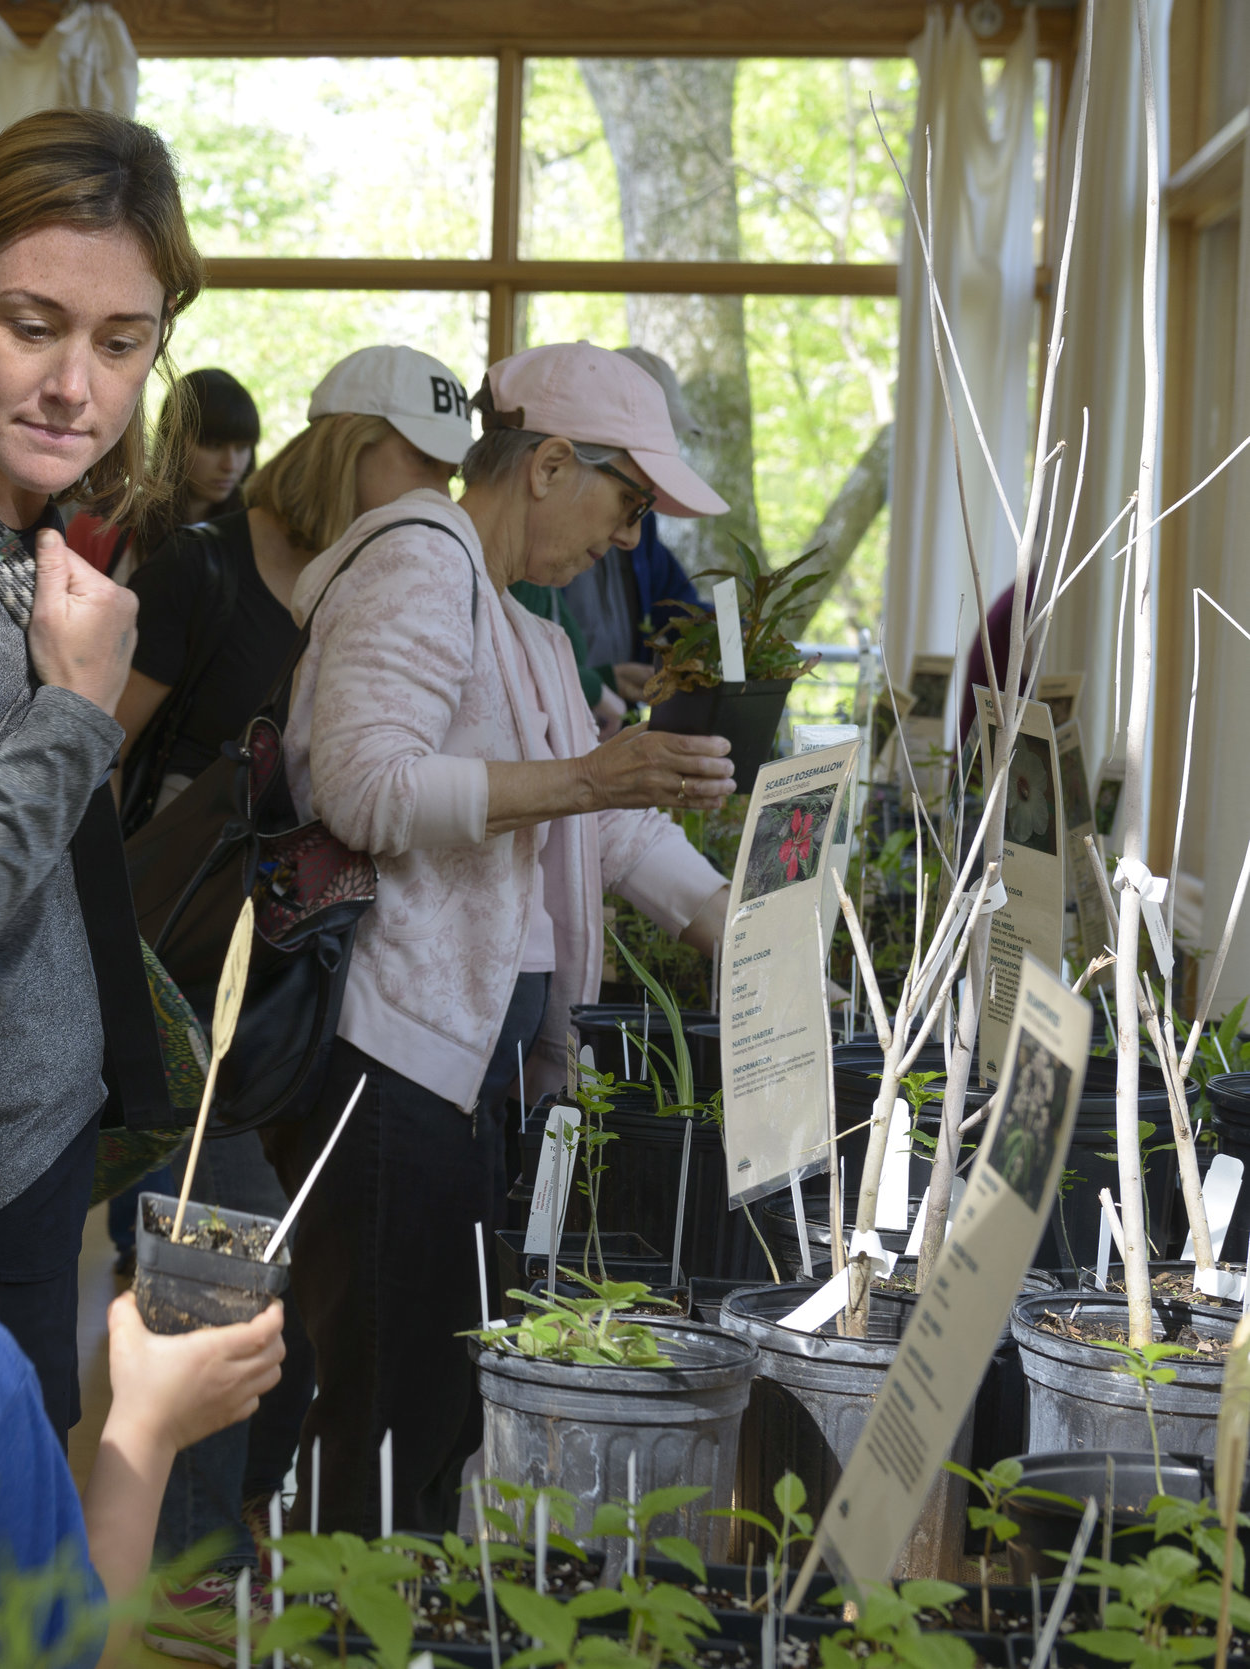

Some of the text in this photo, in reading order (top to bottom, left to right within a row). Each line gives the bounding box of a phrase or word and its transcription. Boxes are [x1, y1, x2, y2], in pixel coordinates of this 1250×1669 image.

[764, 760, 845, 791] SCARLET ROSEMALLOW
[1002, 922, 1014, 932] NEEDS
[733, 948, 772, 968] BLOOM COLOR
[732, 1006, 762, 1022] SOIL NEEDS
[732, 1035, 752, 1048] NATIVE
[752, 1027, 774, 1040] HABITAT
[733, 1056, 772, 1074] INFORMATION
